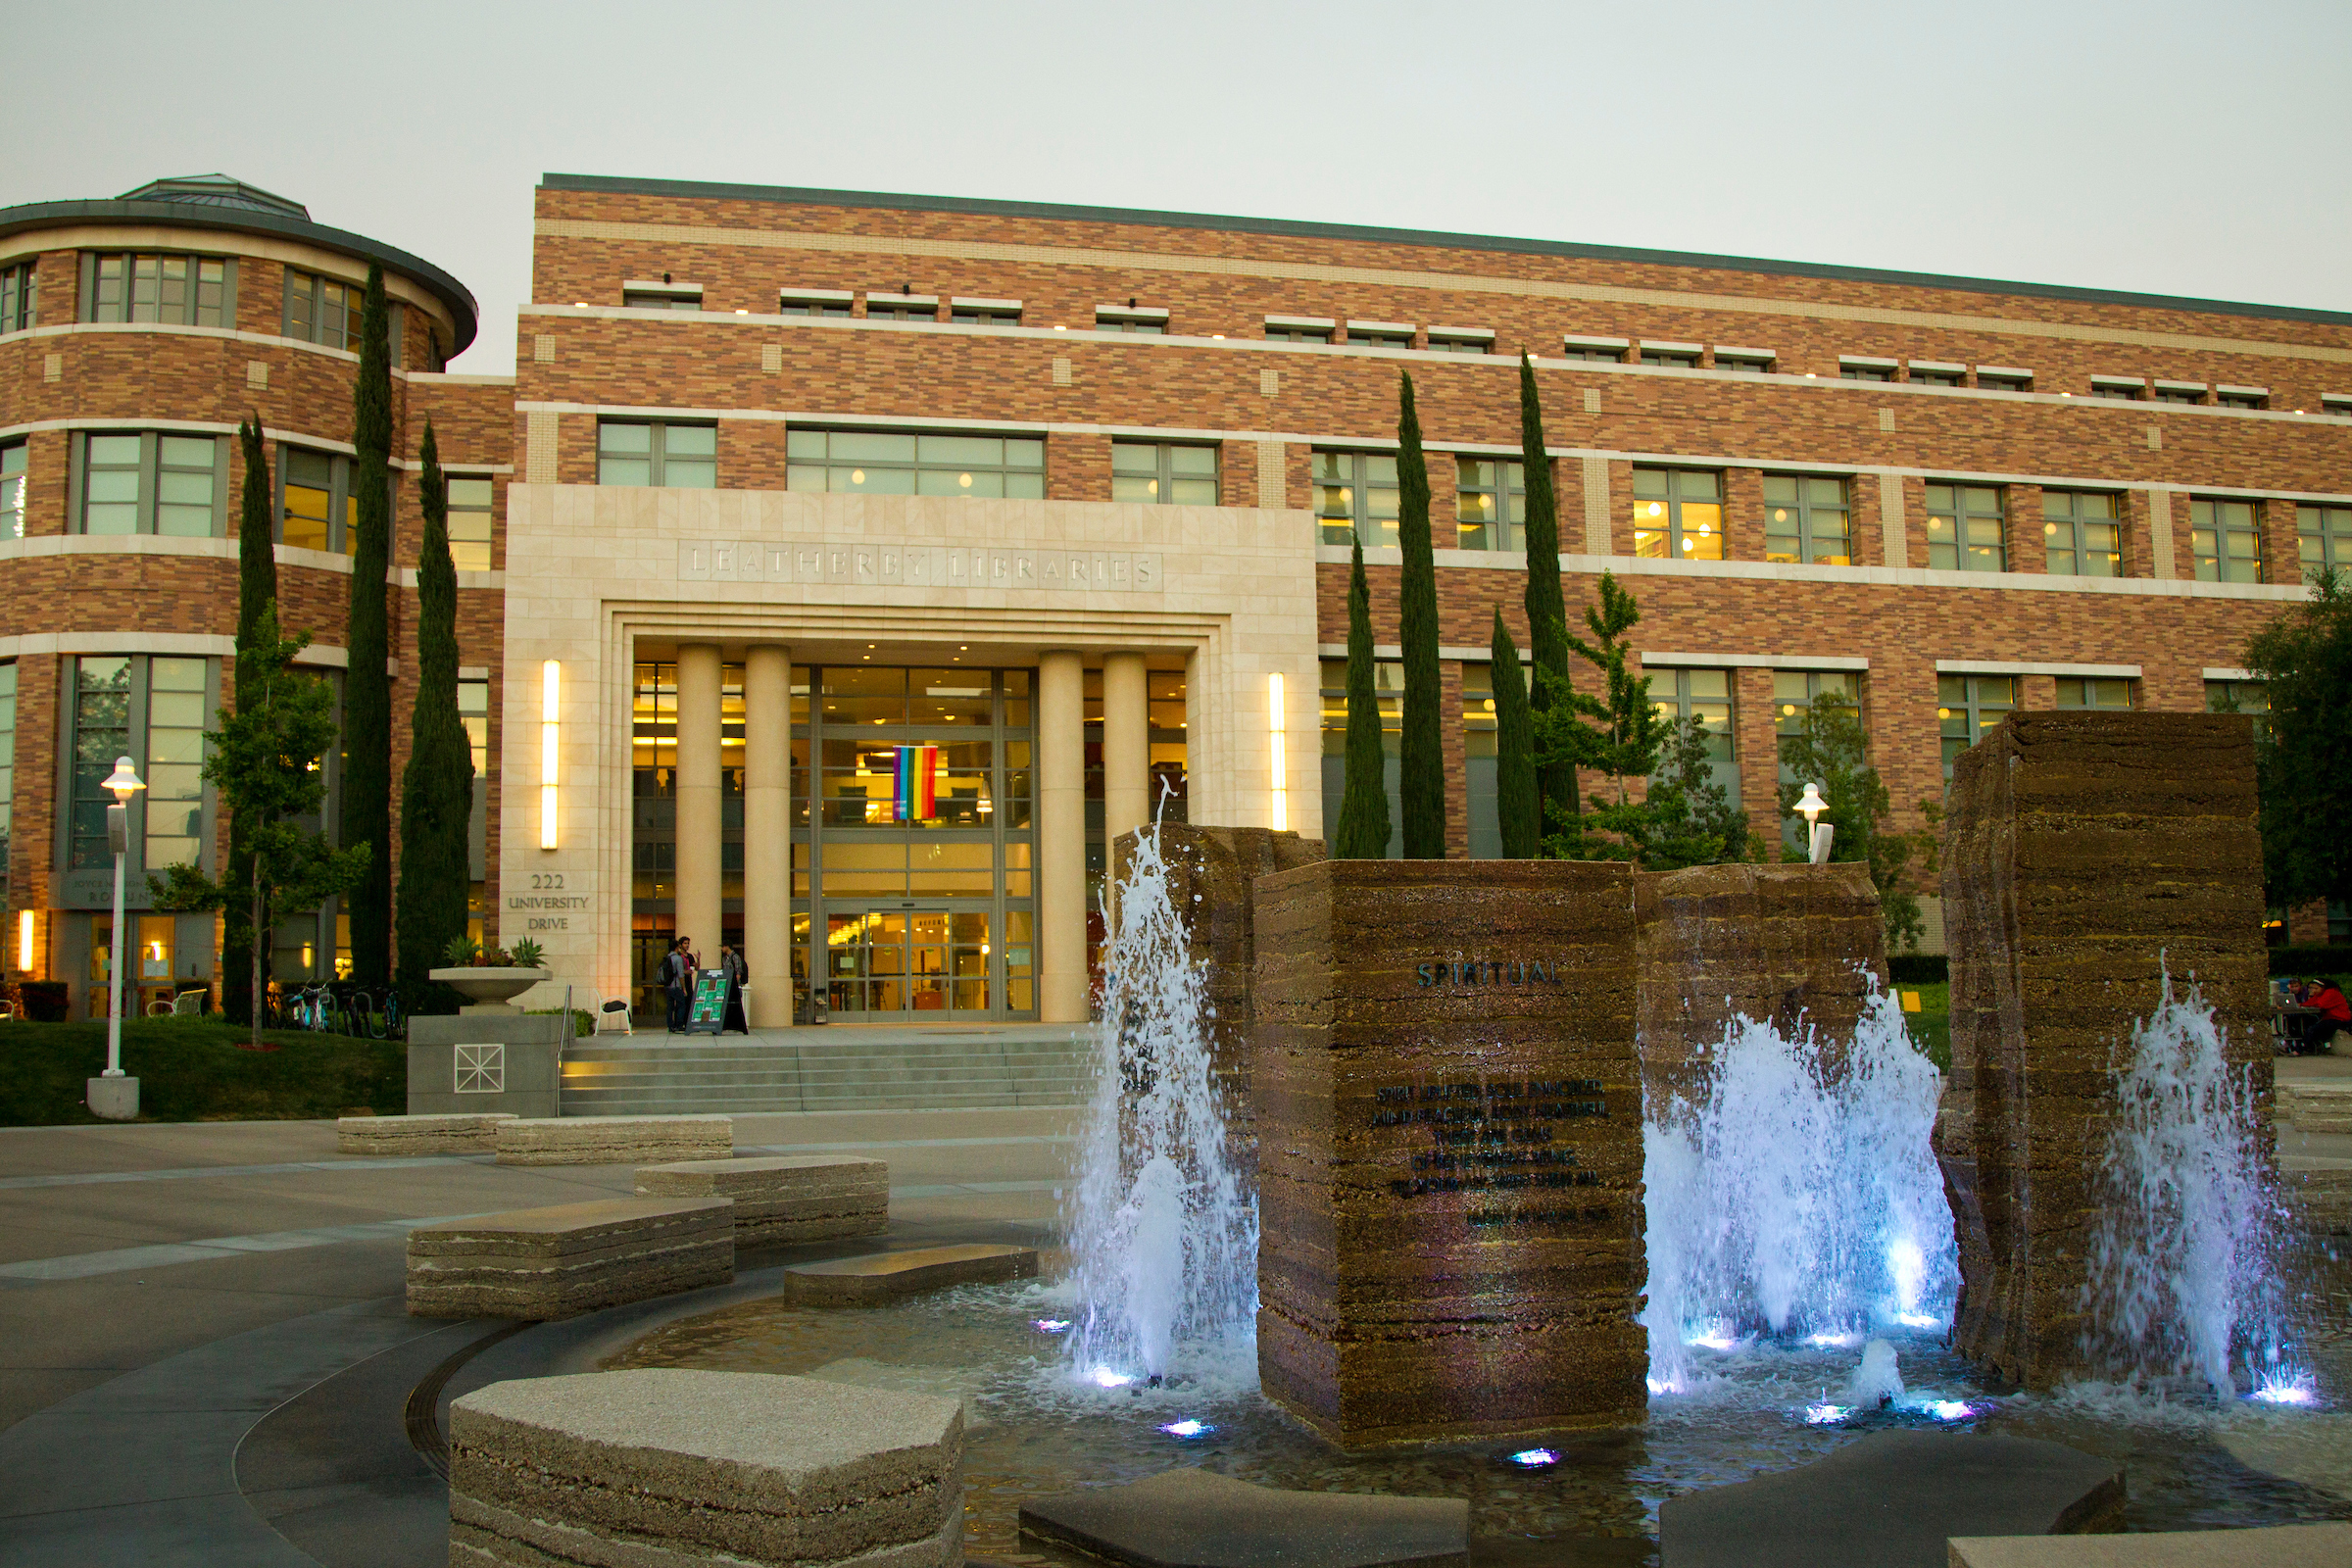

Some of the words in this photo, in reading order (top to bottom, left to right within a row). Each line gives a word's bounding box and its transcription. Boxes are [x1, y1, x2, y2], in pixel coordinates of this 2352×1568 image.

[690, 547, 927, 576] LEATHERBY
[950, 555, 1152, 582] LIBRARIES
[531, 874, 564, 889] 222
[509, 897, 589, 908] UNIVERSITY
[528, 918, 568, 930] DRIVE
[1417, 960, 1563, 987] SPIRITUAL
[1376, 1086, 1414, 1102] SPIRIT
[1486, 1082, 1524, 1099] SOUL
